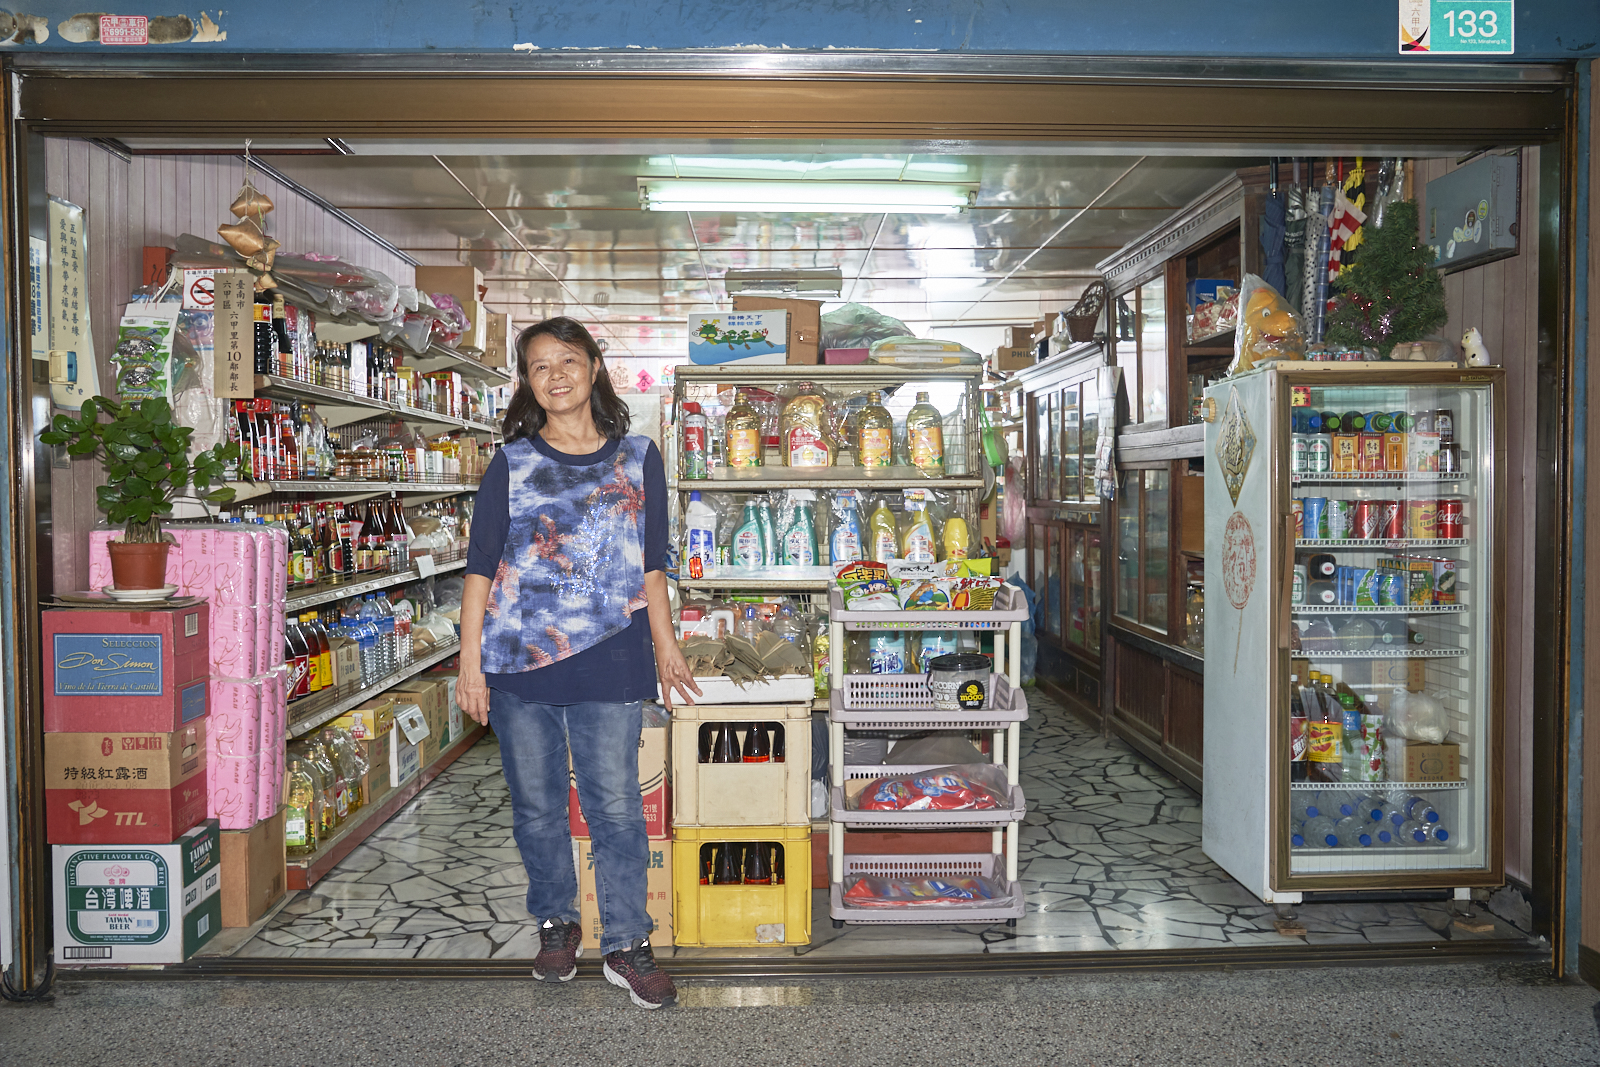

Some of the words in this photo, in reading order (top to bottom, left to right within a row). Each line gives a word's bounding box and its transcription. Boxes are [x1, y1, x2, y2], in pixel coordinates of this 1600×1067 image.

[109, 28, 145, 36] 6991-538
[1411, 8, 1420, 36] 六甲區
[1443, 10, 1498, 37] 133
[222, 280, 232, 310] 六甲區
[236, 279, 246, 310] 臺南市
[226, 311, 242, 392] 六甲里第10鄰鄰長
[58, 652, 108, 669] Don
[94, 653, 158, 671] Simon
[59, 682, 77, 691] Vino
[77, 682, 86, 691] de
[86, 682, 95, 691] la
[97, 682, 119, 691] Tierra
[119, 682, 129, 691] de
[130, 682, 159, 691] Castilla
[64, 766, 148, 780] 特級紅露酒
[114, 812, 148, 826] TTL
[189, 838, 213, 863] TAIWAN
[69, 853, 100, 885] DISTINCTIVE
[135, 853, 160, 864] LAGER
